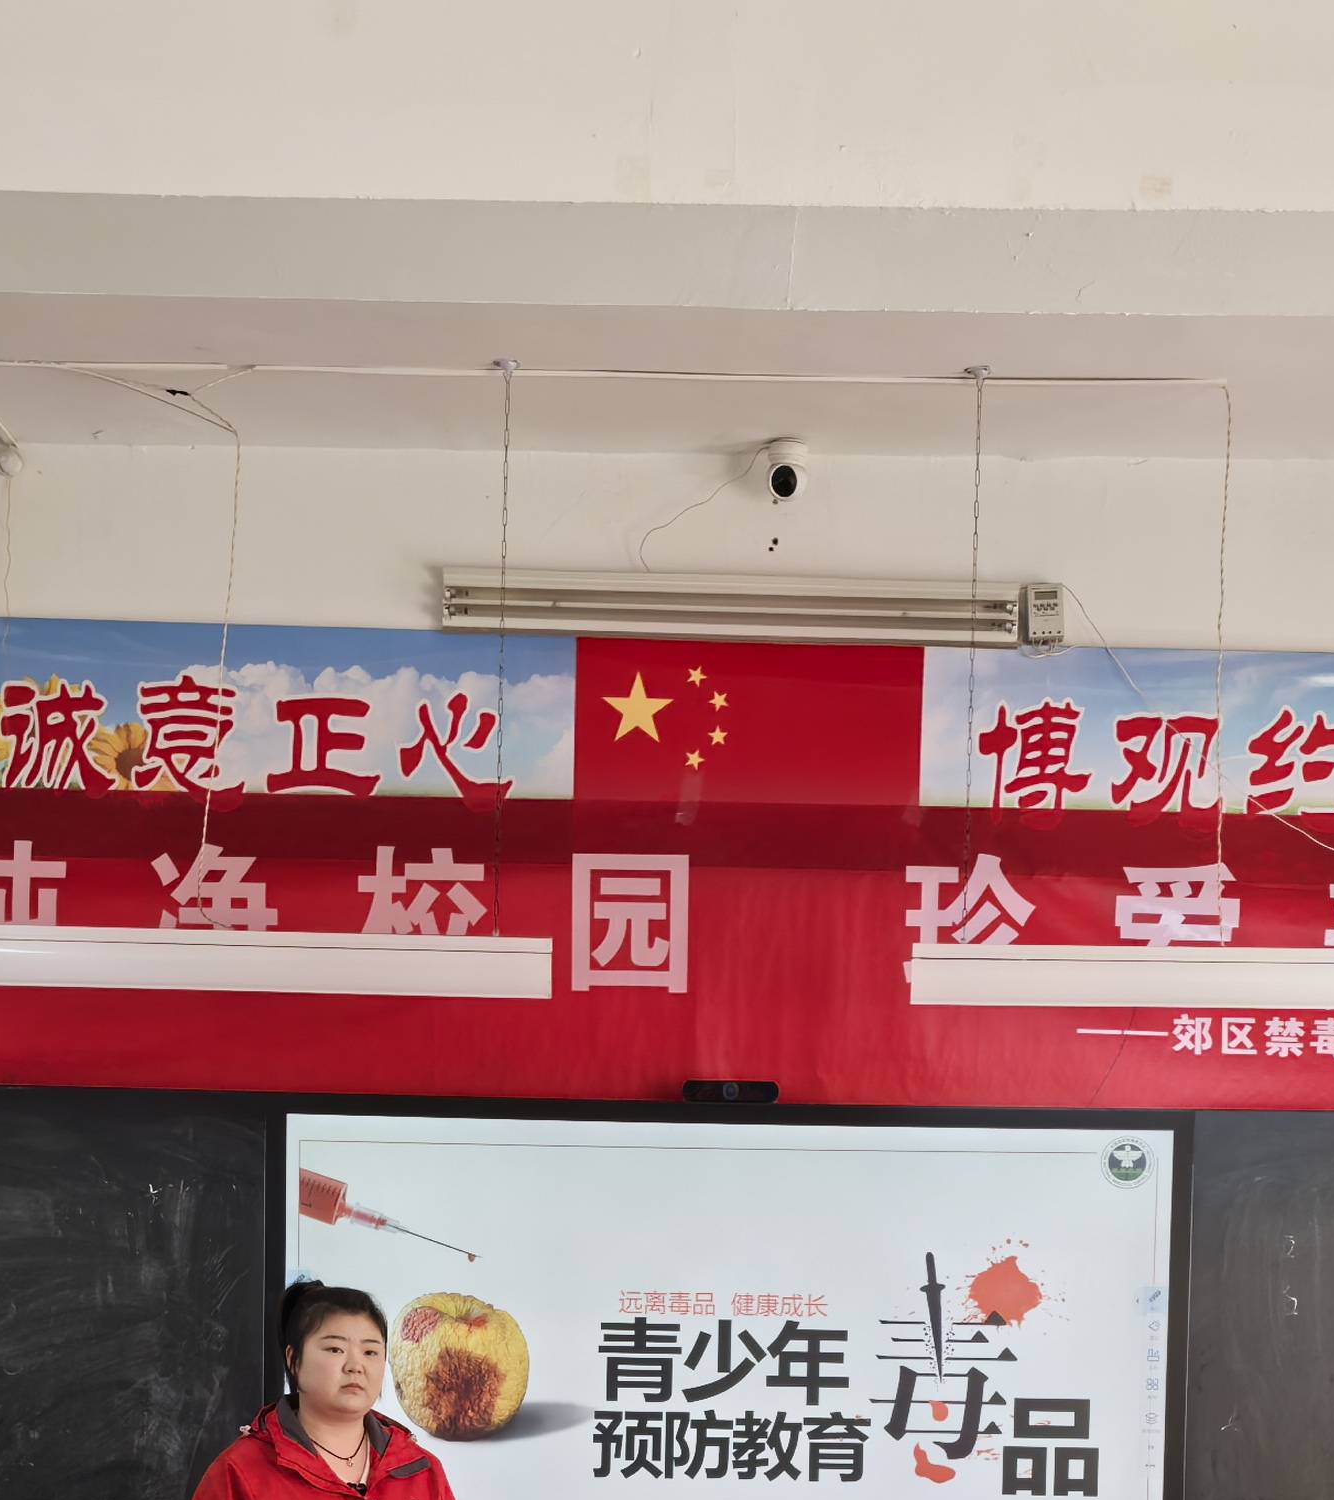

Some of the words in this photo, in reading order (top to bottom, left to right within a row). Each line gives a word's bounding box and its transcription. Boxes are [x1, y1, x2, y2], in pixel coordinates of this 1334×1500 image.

[1, 674, 514, 806] 诚意正心
[618, 1290, 715, 1316] 远离毒品
[731, 1292, 828, 1317] 健康成长
[598, 1317, 849, 1406] 青少年
[593, 1409, 871, 1483] 预防教育
